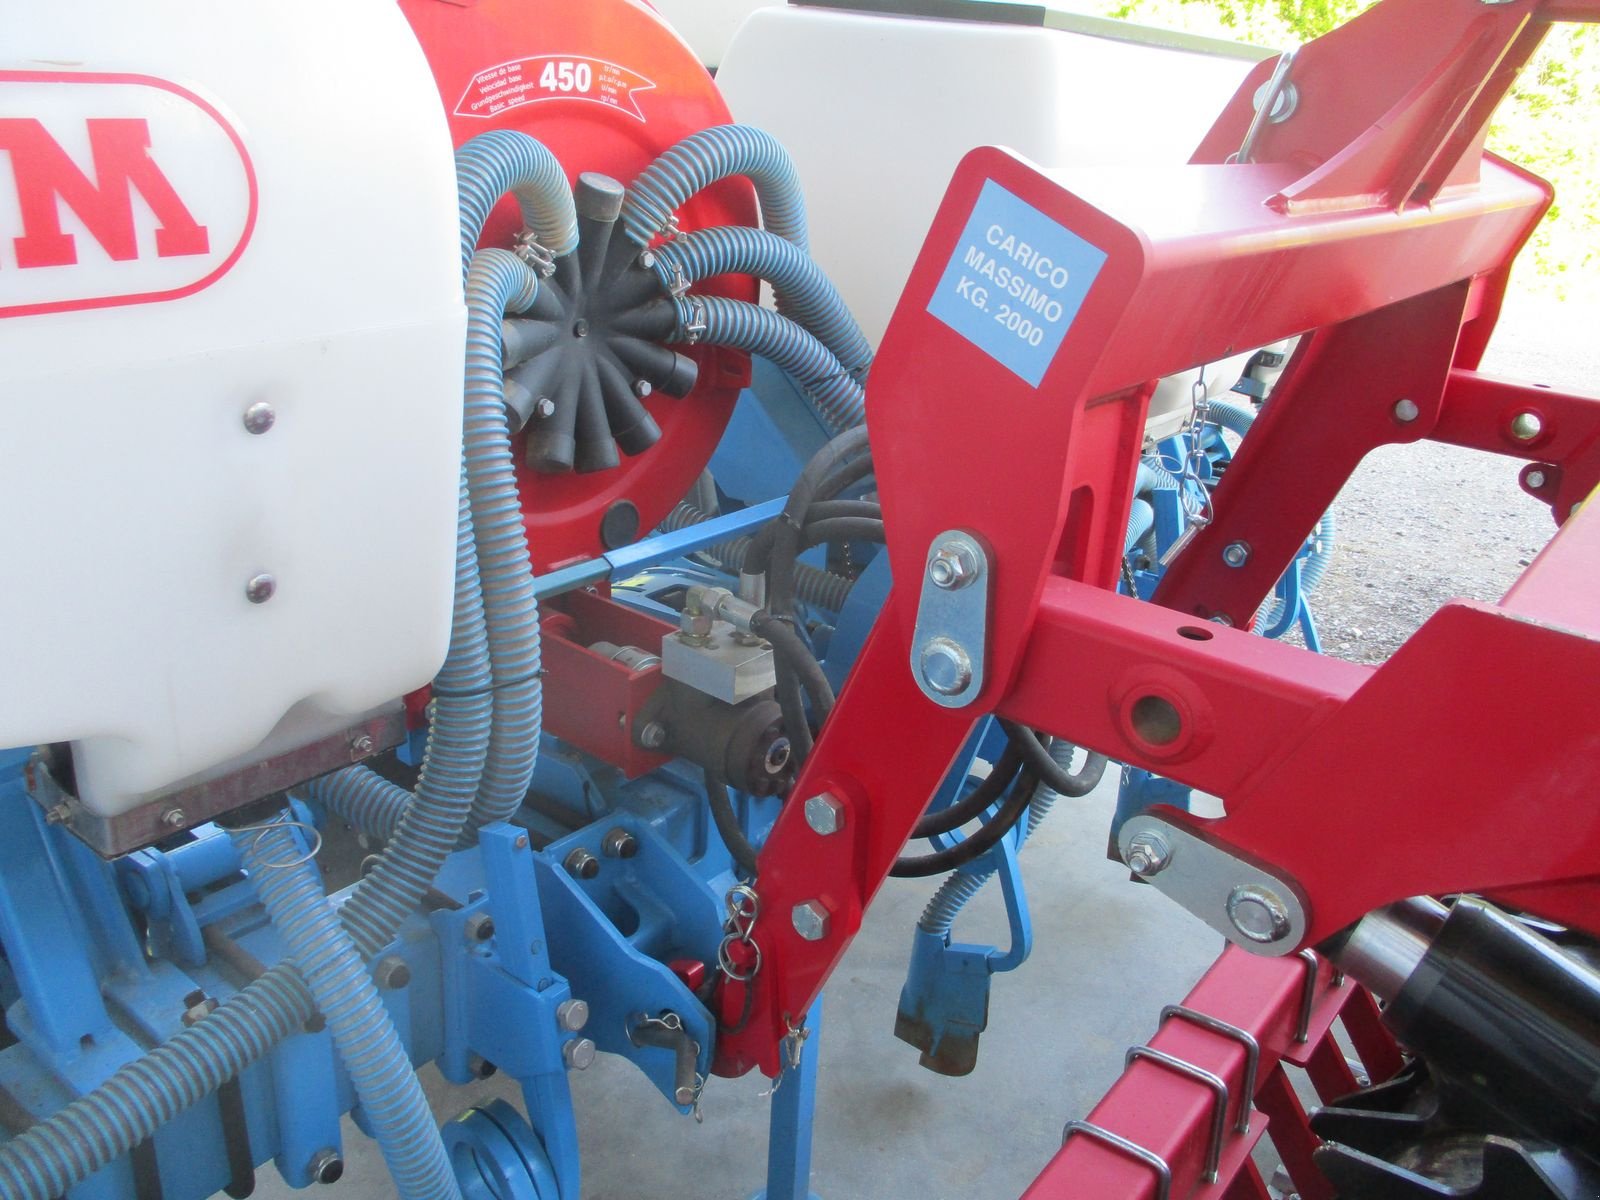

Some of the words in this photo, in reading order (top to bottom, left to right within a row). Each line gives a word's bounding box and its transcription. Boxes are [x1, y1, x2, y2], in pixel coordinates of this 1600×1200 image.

[499, 67, 507, 76] de
[507, 64, 522, 73] base
[508, 75, 522, 83] base
[540, 61, 592, 93] 450
[489, 102, 505, 112] Basic
[508, 94, 525, 106] speed
[986, 224, 1069, 289] CARICO
[964, 245, 1063, 322] MASSIMO
[956, 275, 990, 313] KG.
[994, 304, 1044, 347] 2000
